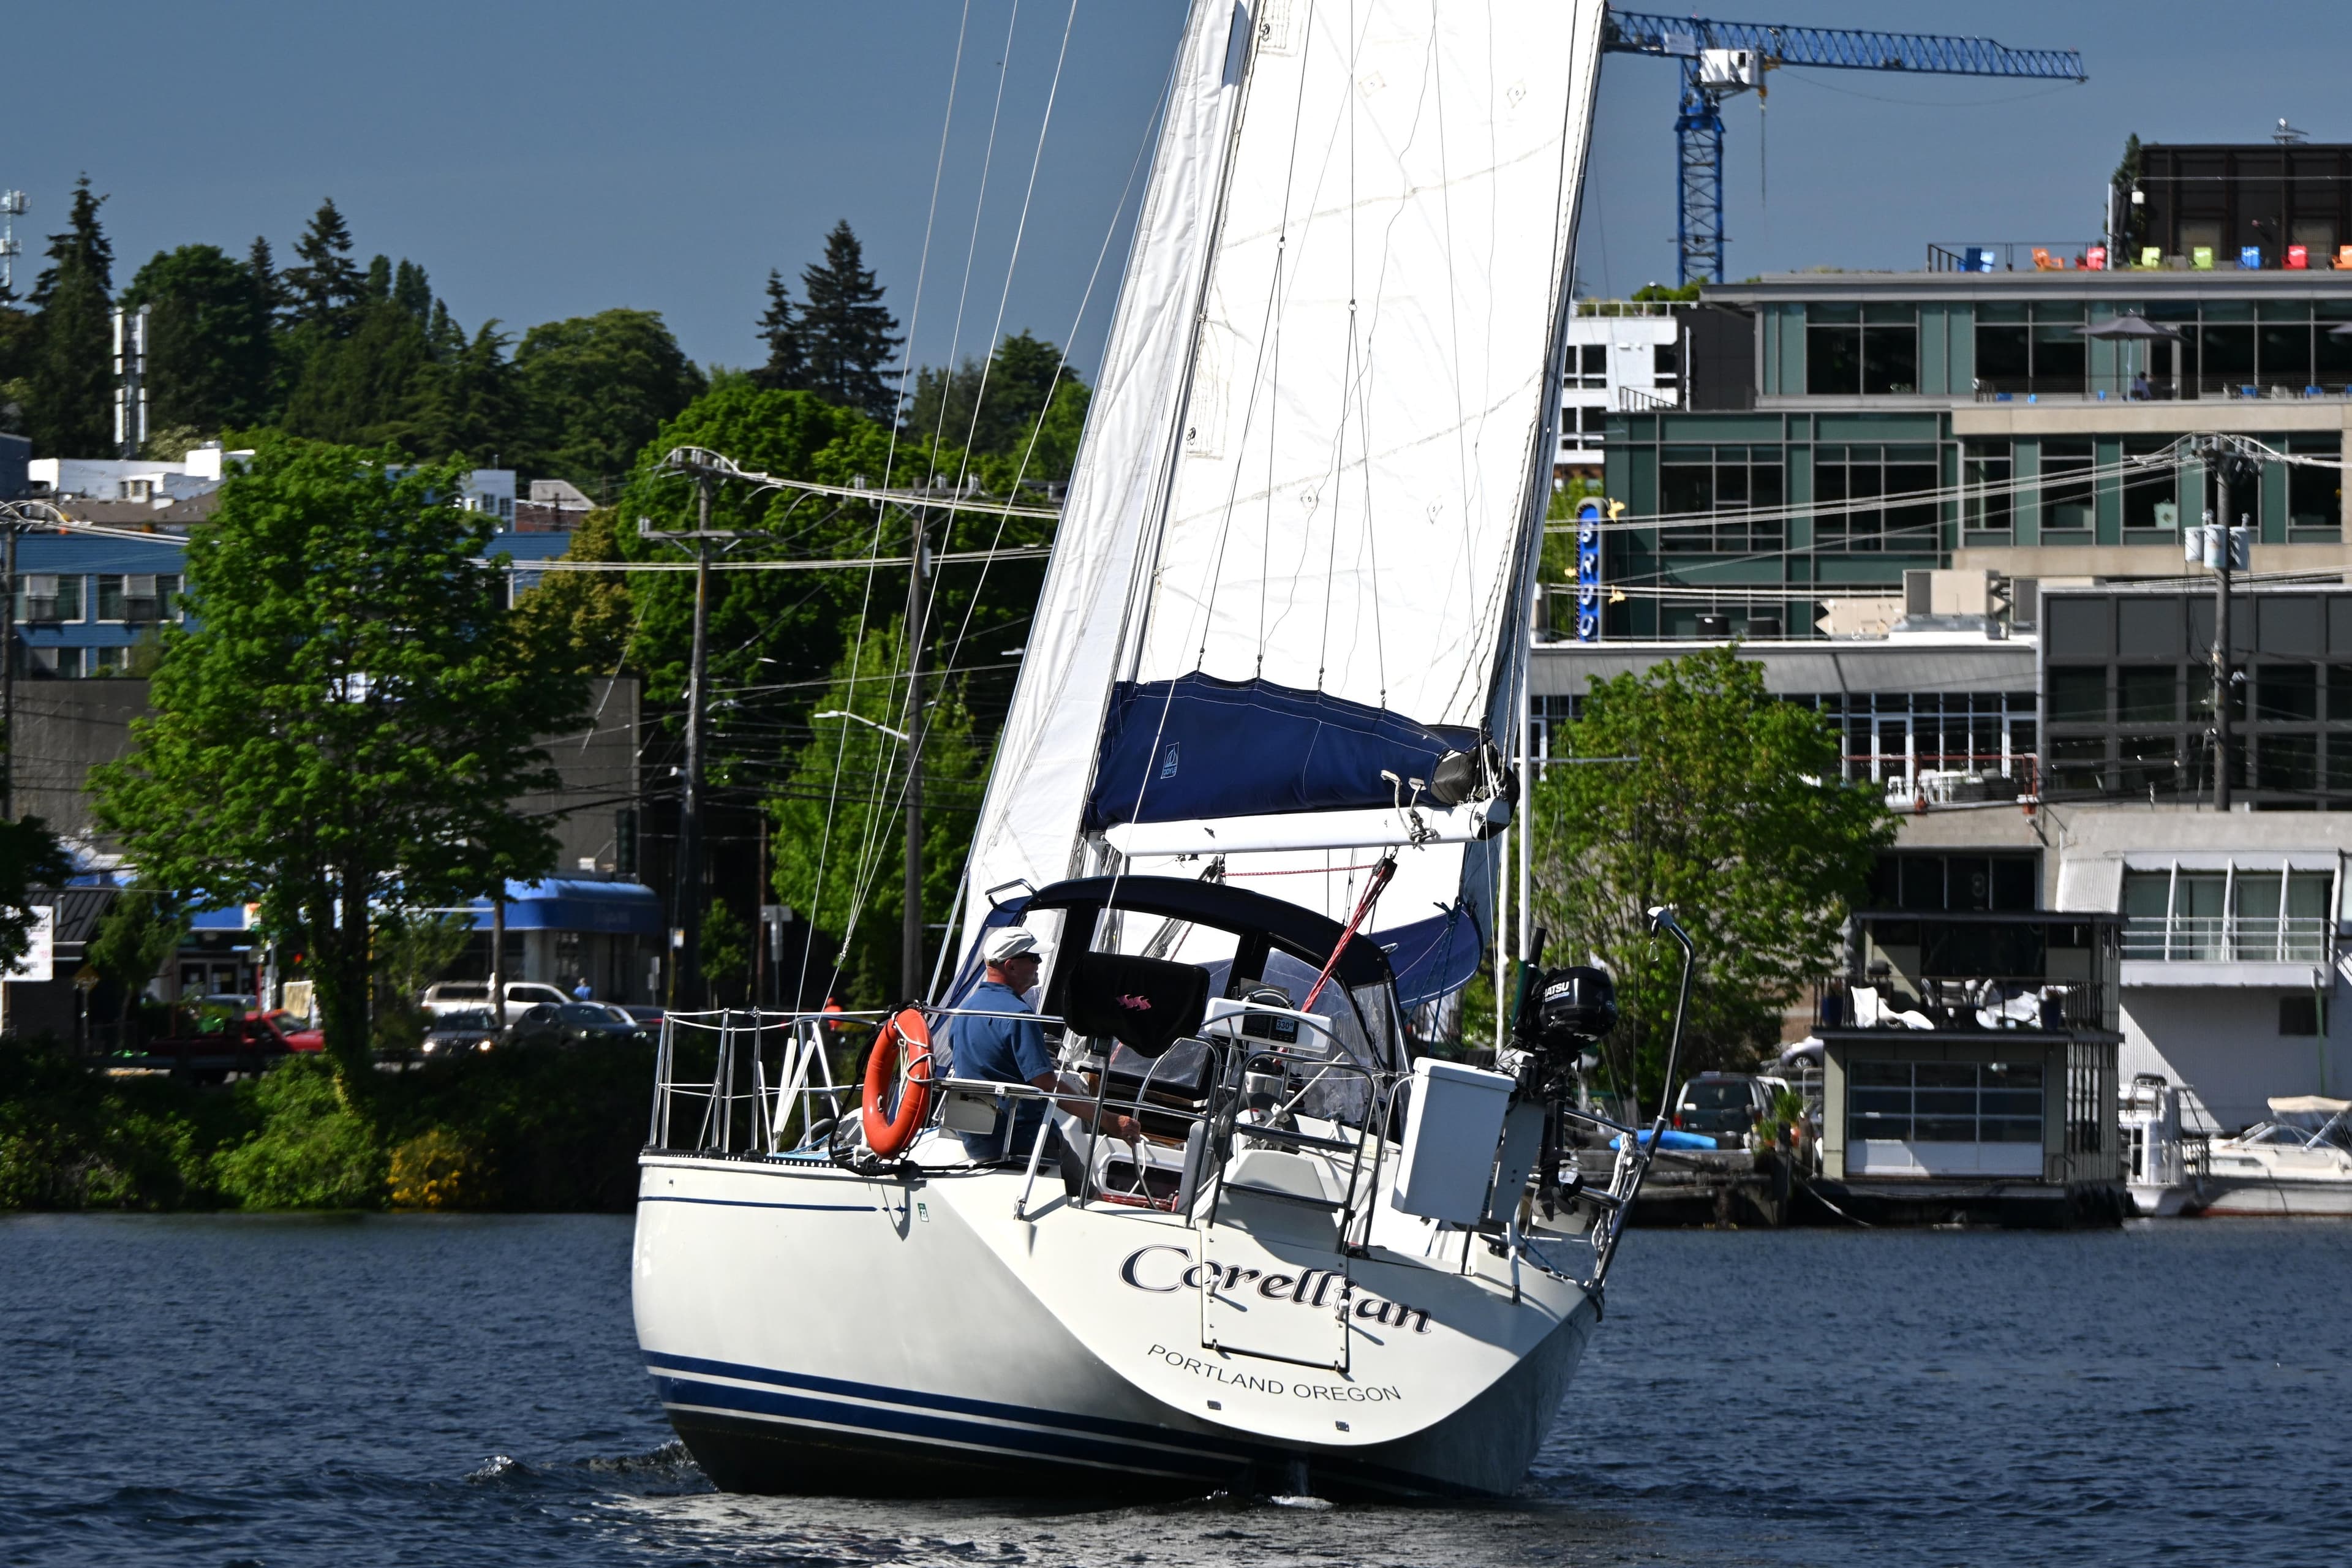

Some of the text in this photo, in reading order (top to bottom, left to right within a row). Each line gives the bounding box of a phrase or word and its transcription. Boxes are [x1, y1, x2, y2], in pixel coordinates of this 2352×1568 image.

[1163, 766, 1177, 775] DOYLE
[1118, 1243, 1431, 1334] Corellian
[1148, 1344, 1403, 1402] PORTLAND OREGON
